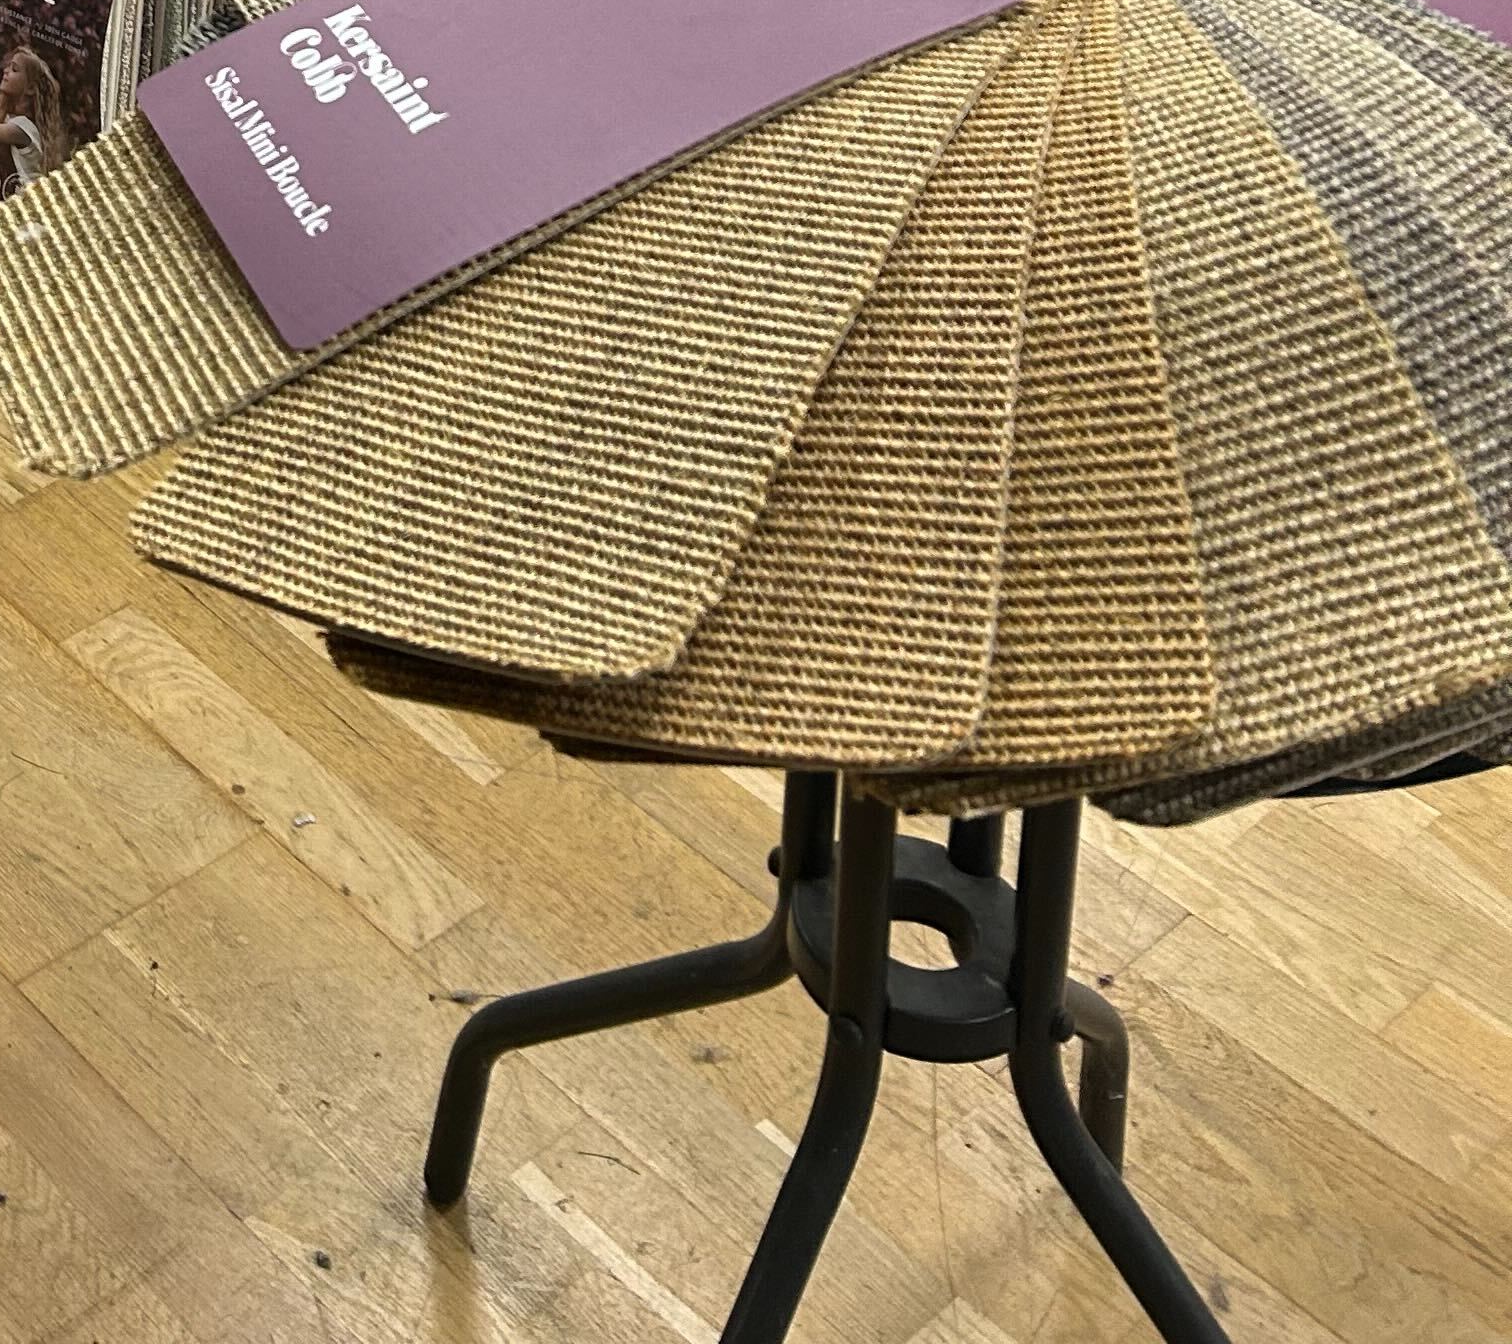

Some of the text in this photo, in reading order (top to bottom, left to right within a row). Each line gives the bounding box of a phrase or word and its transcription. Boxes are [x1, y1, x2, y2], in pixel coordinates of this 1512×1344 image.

[280, 27, 359, 104] Cobb
[322, 4, 450, 135] Kersaint
[204, 65, 334, 237] Sisal Mini Boucle
